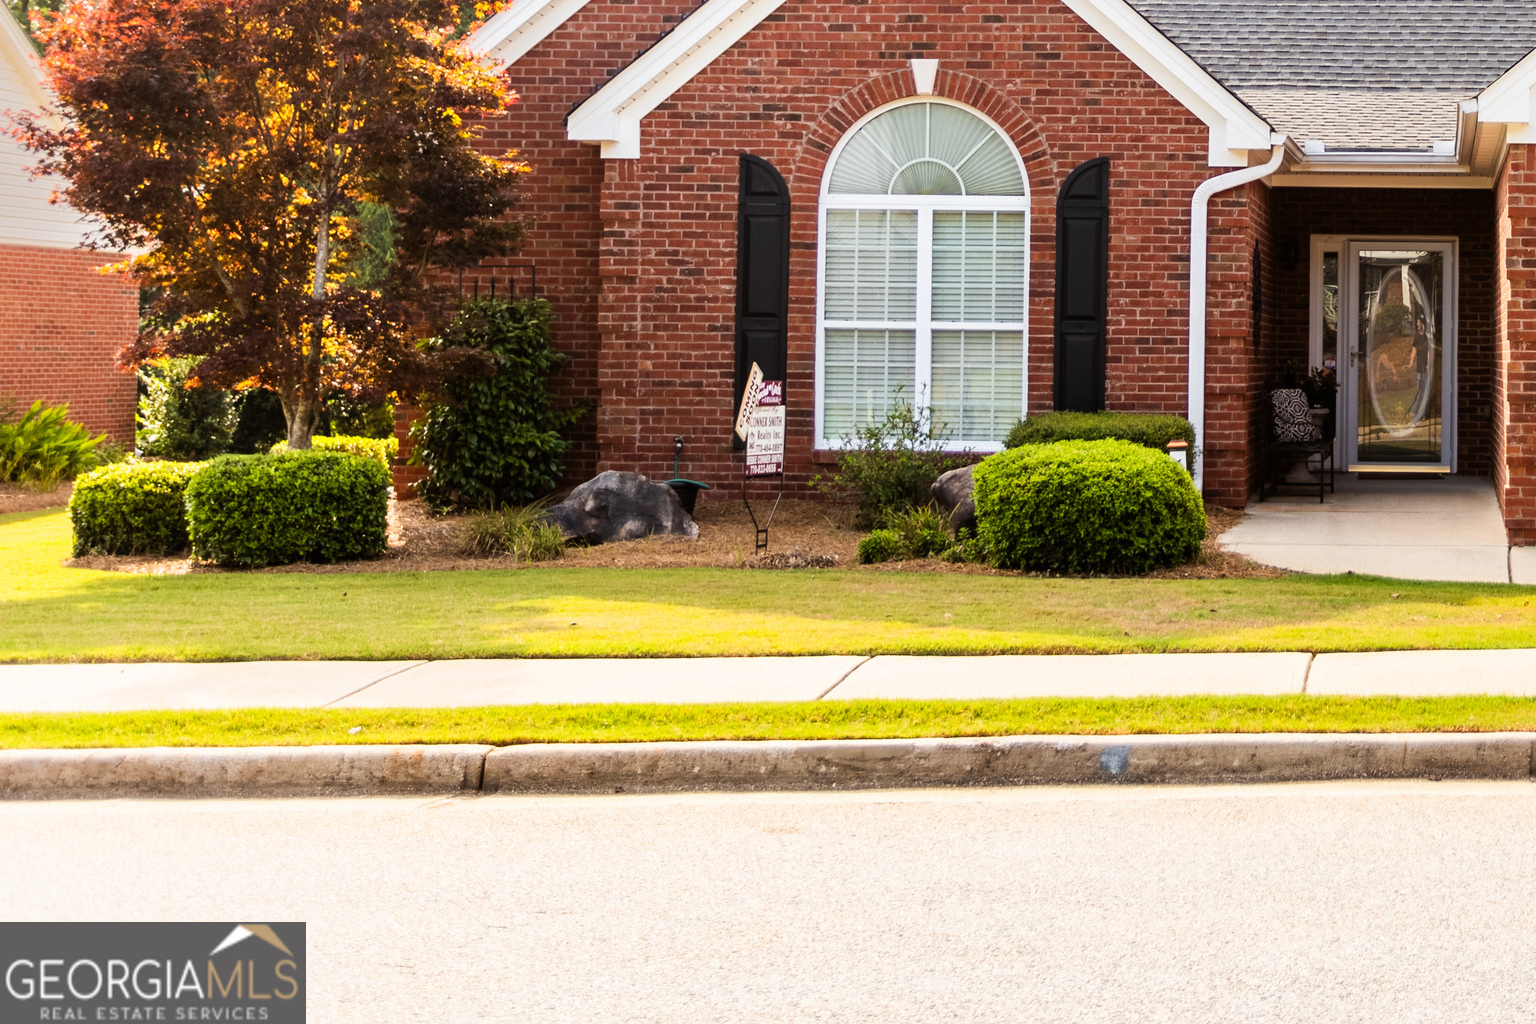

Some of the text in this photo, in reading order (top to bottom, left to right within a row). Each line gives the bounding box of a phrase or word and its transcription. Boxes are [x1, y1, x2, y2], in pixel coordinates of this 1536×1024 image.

[739, 370, 758, 428] COMING
[745, 383, 759, 425] SOON
[750, 416, 783, 428] CONNER SMITH
[757, 429, 783, 442] Realty Inc.
